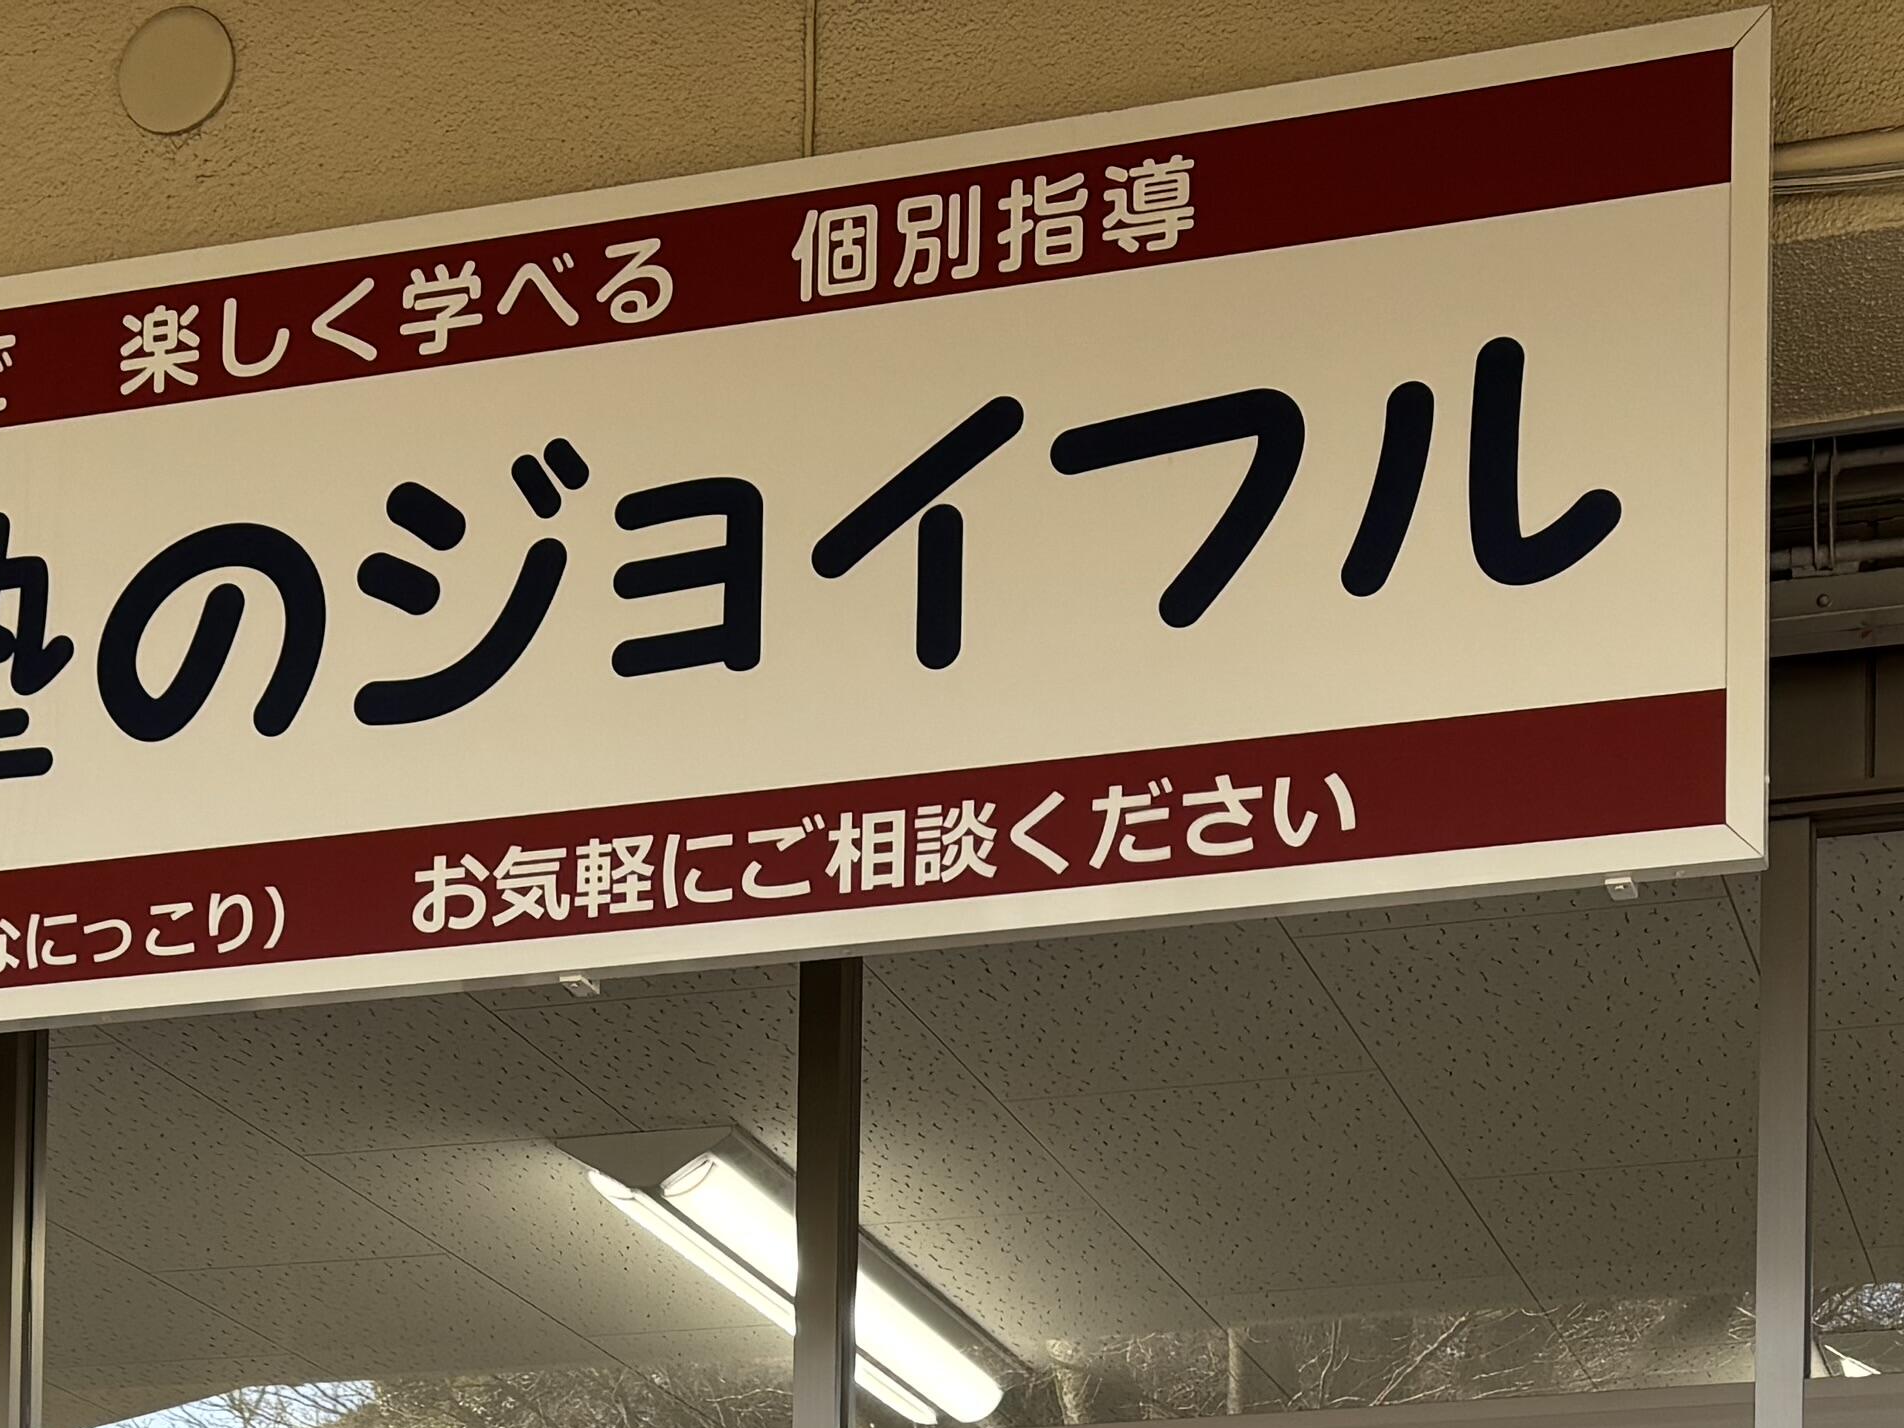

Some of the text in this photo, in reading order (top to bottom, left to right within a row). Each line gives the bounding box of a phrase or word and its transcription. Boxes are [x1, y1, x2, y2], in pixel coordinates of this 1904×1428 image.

[118, 237, 678, 398] 楽しく学べる
[790, 155, 1196, 302] 個別指導
[408, 771, 1357, 938] お気軽にご相談ください
